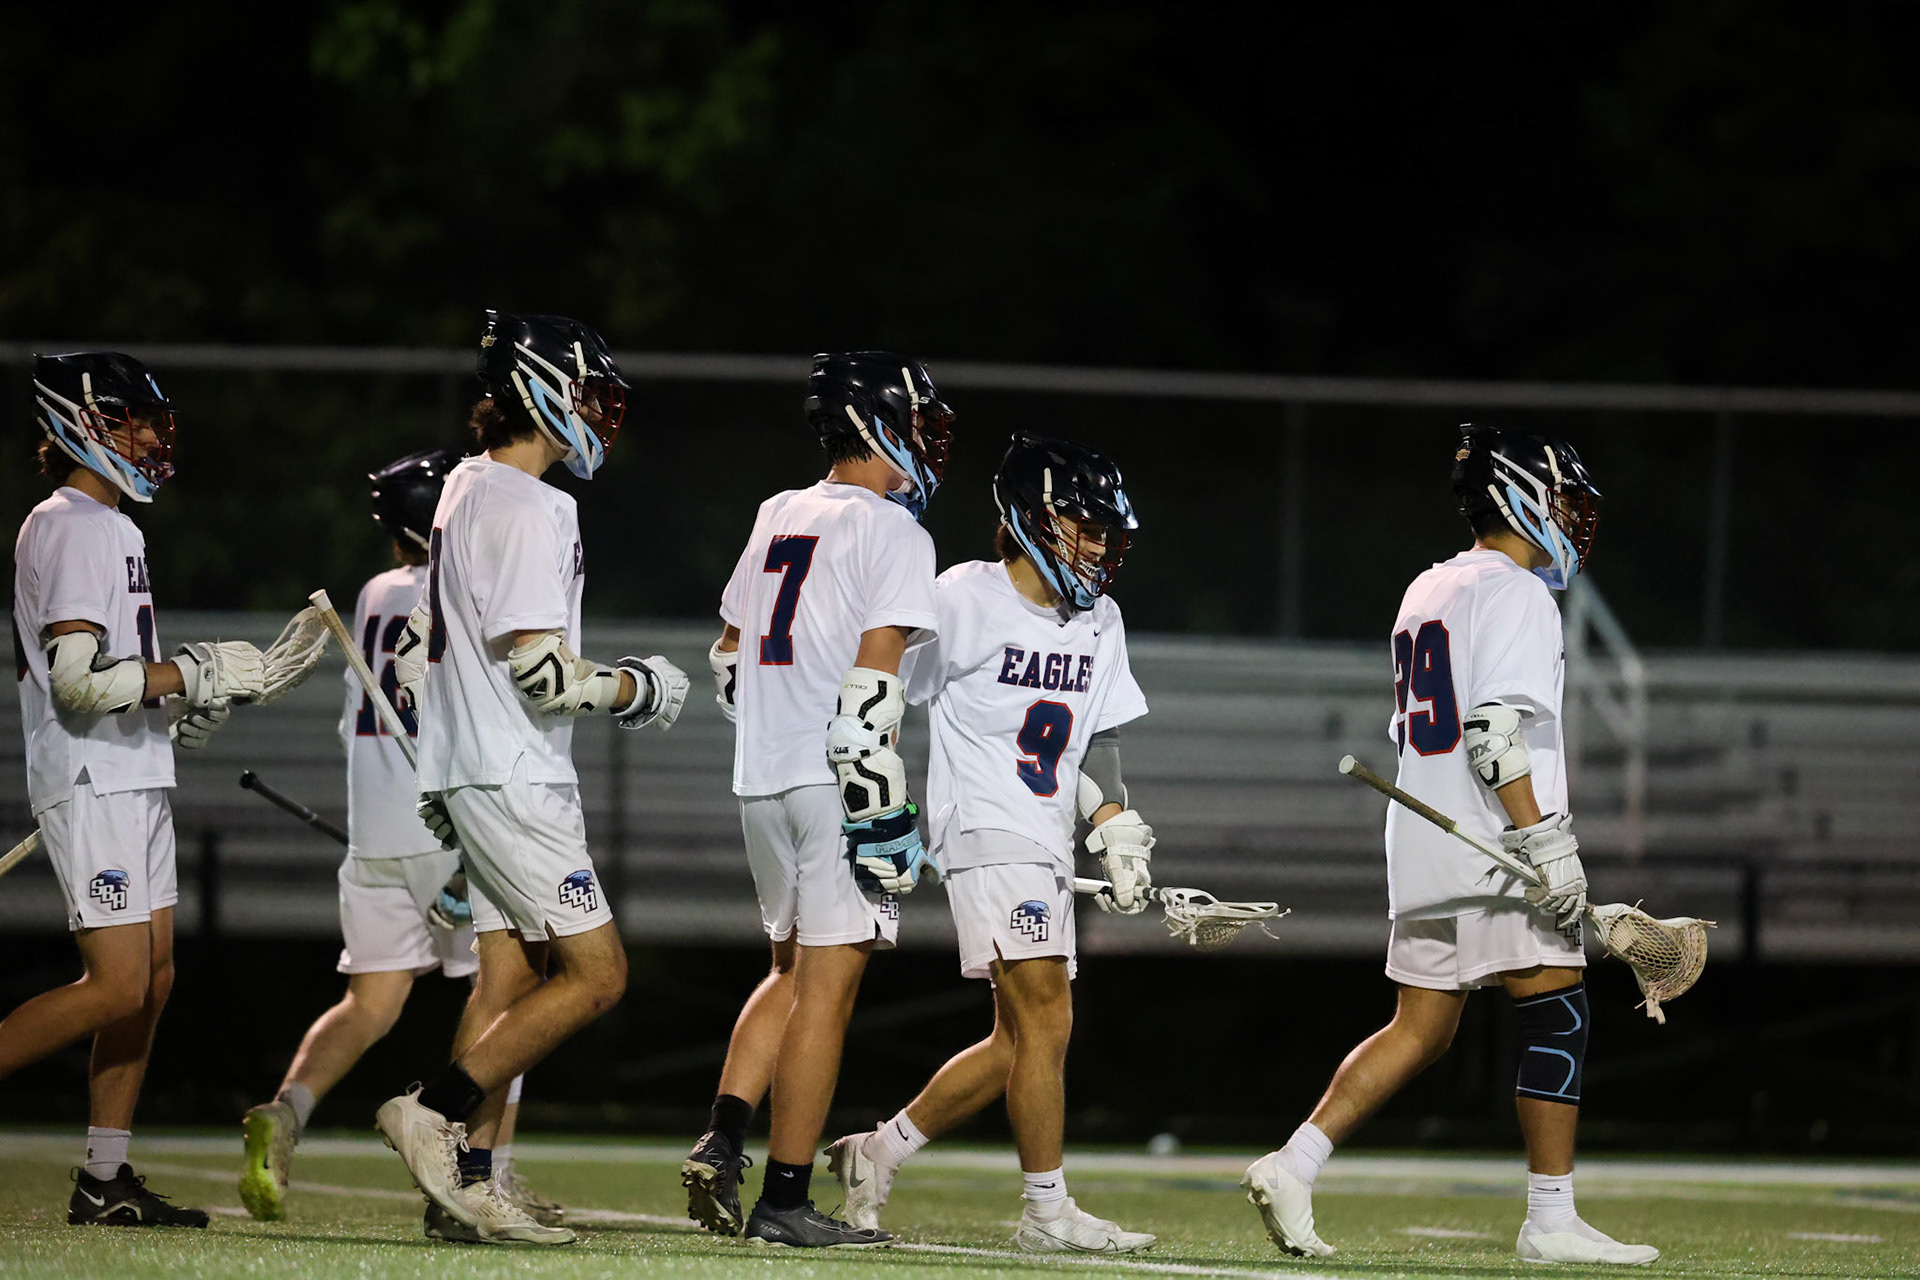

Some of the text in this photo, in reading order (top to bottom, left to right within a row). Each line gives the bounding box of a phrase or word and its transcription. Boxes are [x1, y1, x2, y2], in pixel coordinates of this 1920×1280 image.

[759, 534, 820, 666] 7
[1016, 699, 1075, 798] 9
[90, 878, 128, 911] SBA
[558, 881, 598, 914] SBA
[880, 893, 900, 920] SB
[1010, 908, 1049, 943] SBA
